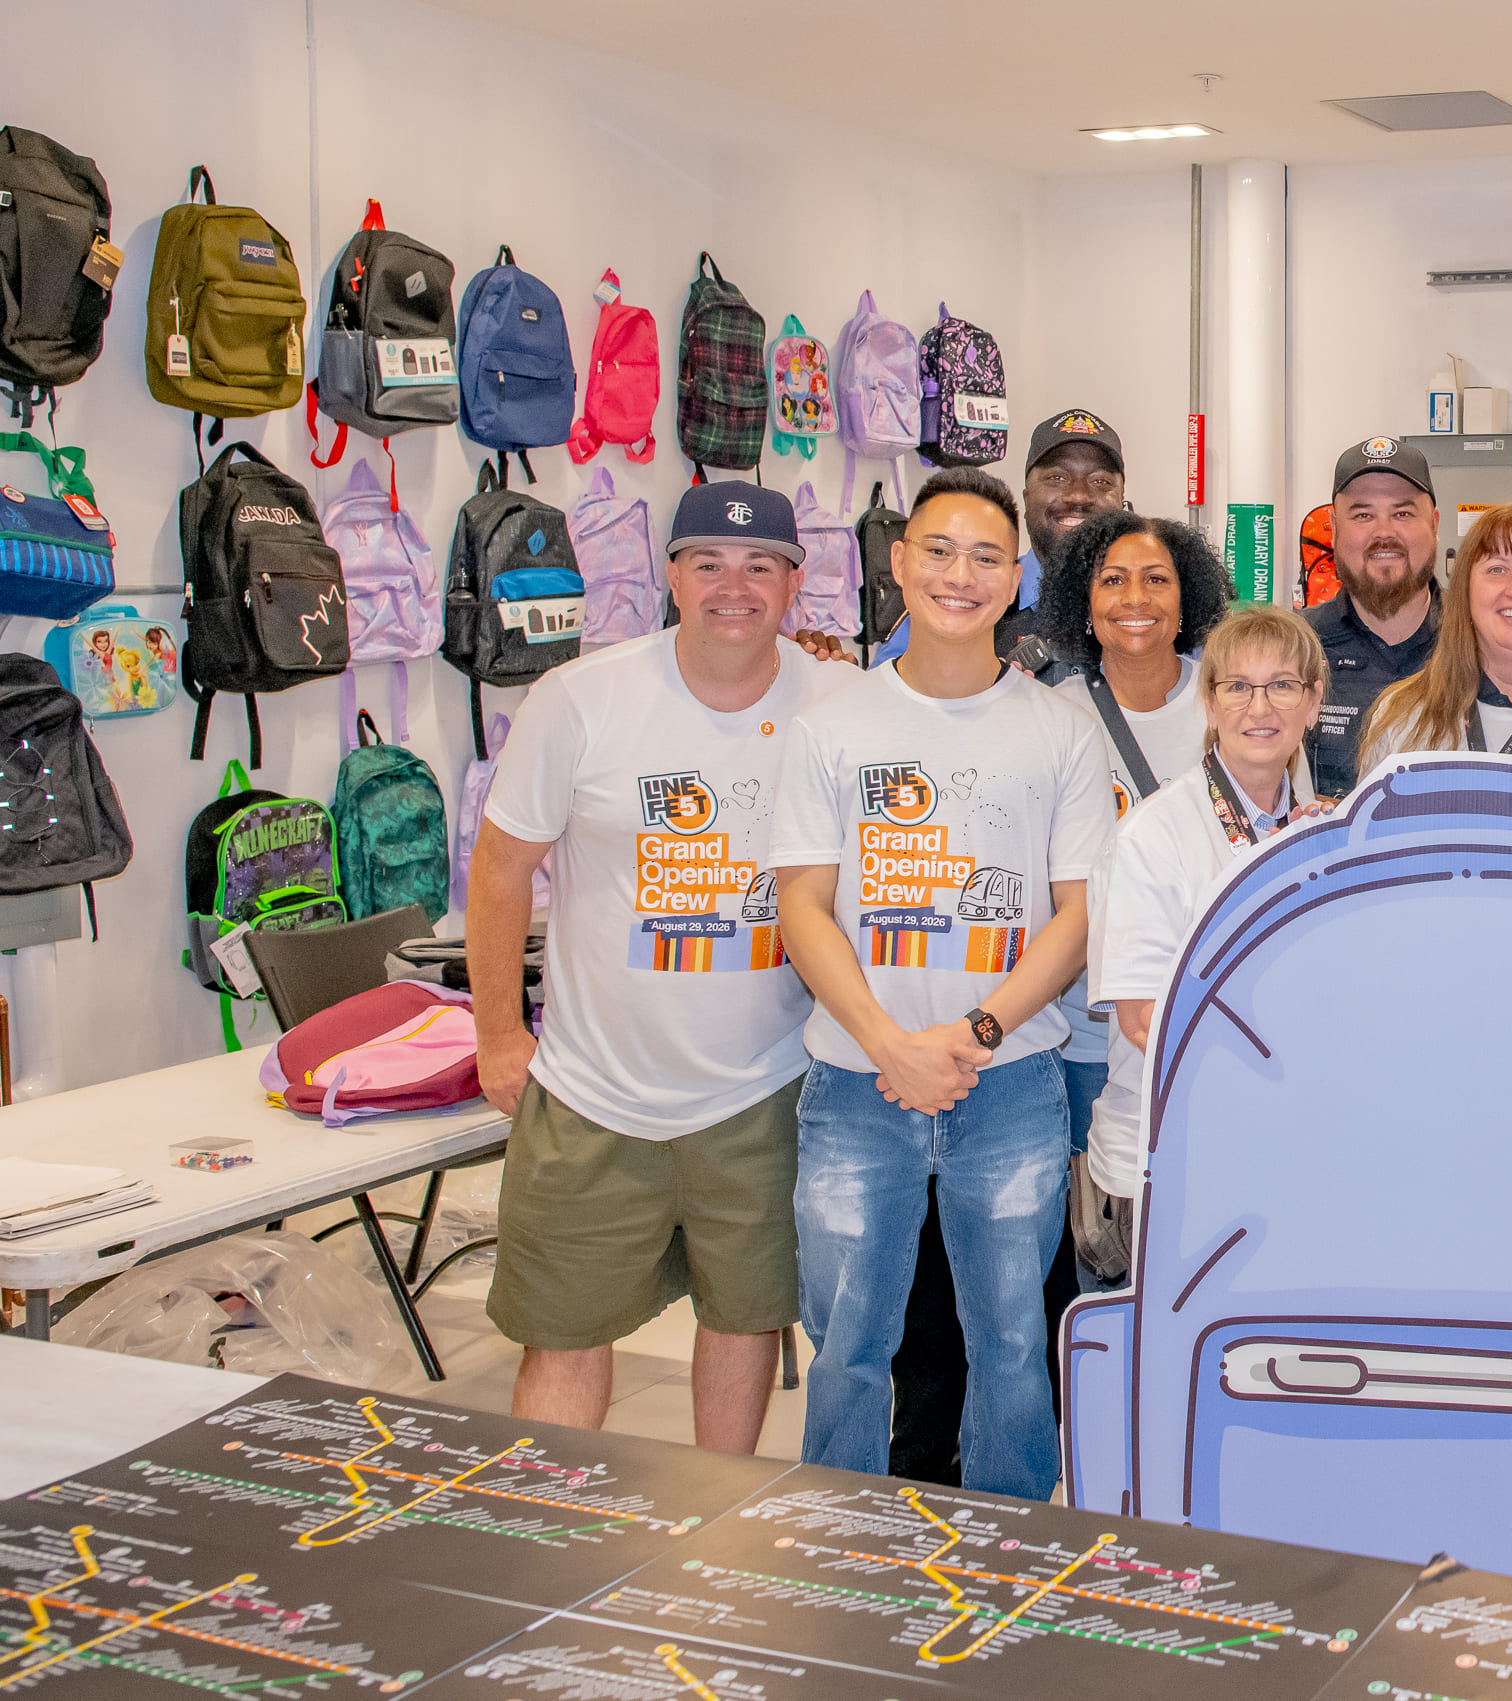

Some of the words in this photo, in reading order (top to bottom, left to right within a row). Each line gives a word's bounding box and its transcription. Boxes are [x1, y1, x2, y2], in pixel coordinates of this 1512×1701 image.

[1188, 448, 1198, 479] SPRINKLER
[238, 505, 302, 525] CANADA
[1227, 513, 1237, 546] DRAIN
[1254, 514, 1270, 567] SANITARY
[1253, 568, 1268, 601] DRAIN
[1322, 725, 1345, 735] OFFICER
[643, 776, 698, 800] LINE
[864, 766, 919, 789] LINE
[232, 812, 326, 862] MINECRAFT
[640, 836, 723, 860] Grand
[863, 825, 941, 852] Grand
[641, 861, 753, 891] Opening
[861, 851, 971, 886] Opening
[640, 885, 710, 911] Crew
[860, 878, 926, 903] Crew
[651, 920, 688, 934] August
[688, 921, 704, 934] 29,
[706, 922, 730, 933] 2026
[867, 914, 903, 926] August
[903, 915, 920, 927] 29,
[921, 916, 946, 927] 2026
